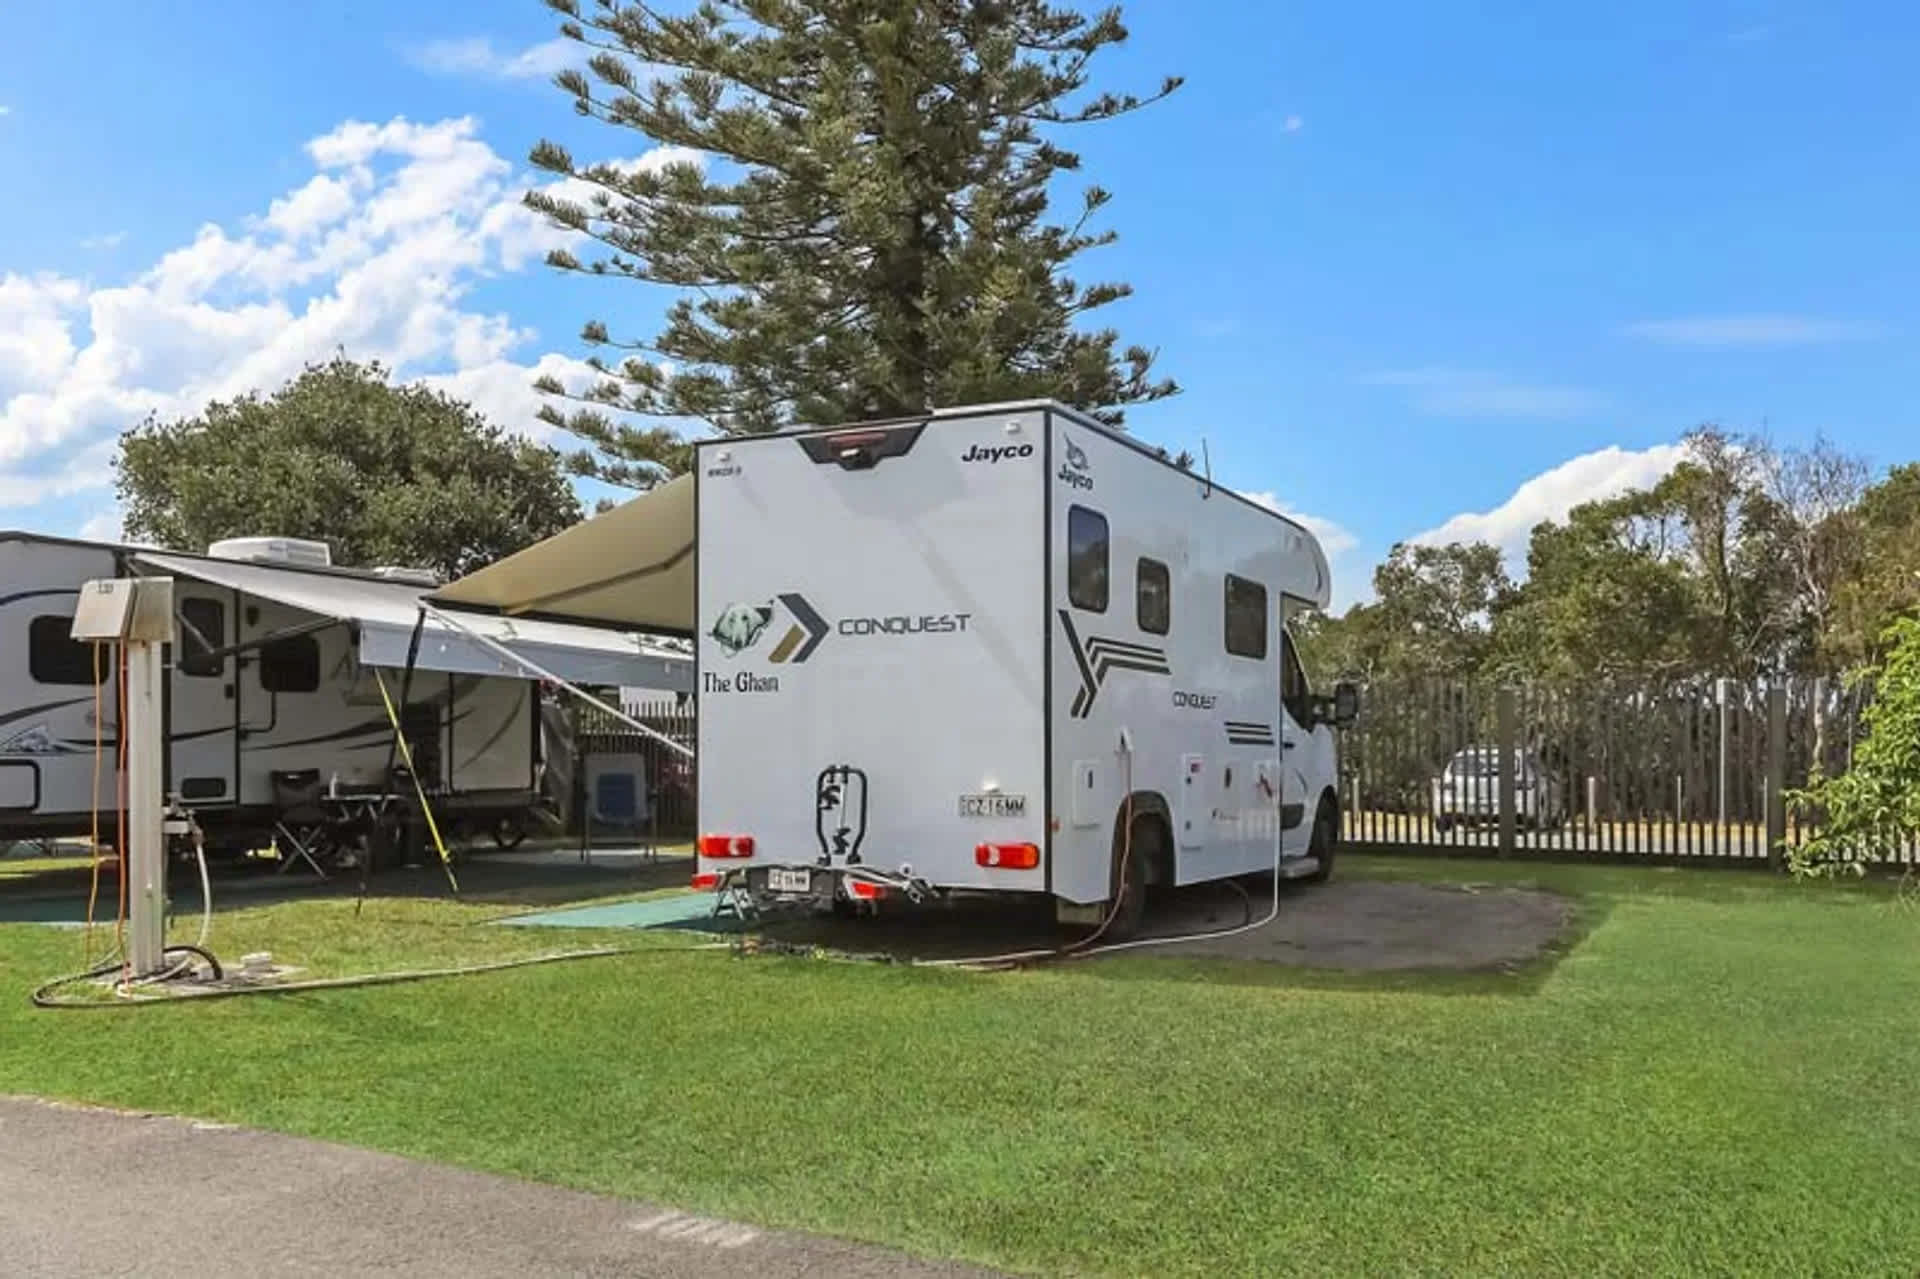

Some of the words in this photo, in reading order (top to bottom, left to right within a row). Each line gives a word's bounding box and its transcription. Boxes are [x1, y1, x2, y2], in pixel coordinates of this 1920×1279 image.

[961, 444, 1034, 463] Jayco
[1058, 463, 1093, 490] Jayco
[838, 614, 971, 635] CONQUEST
[703, 672, 730, 692] The
[735, 671, 779, 692] Ghan
